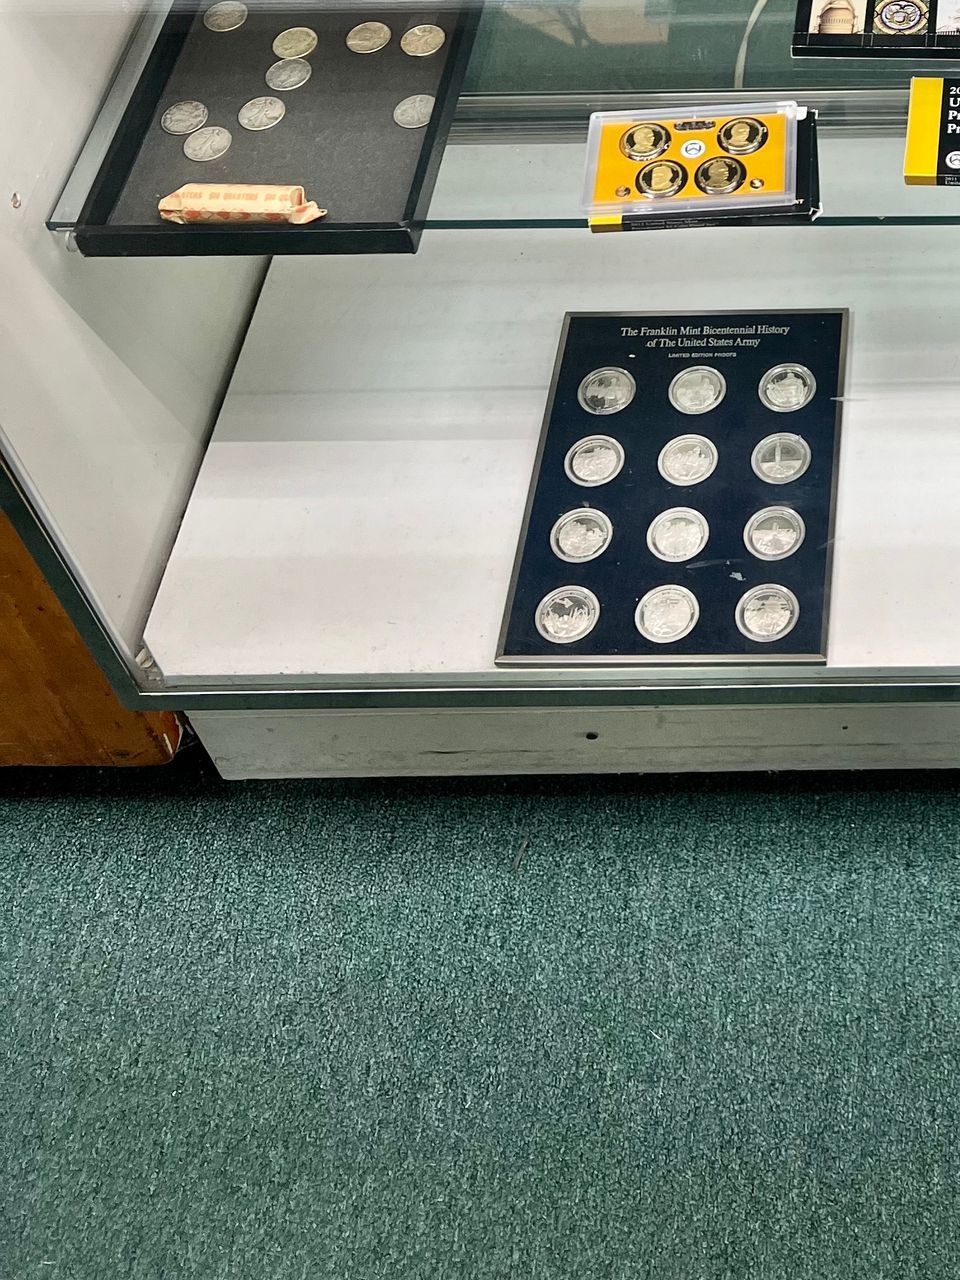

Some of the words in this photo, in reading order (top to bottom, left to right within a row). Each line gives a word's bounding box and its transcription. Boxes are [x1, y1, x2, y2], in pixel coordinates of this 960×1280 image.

[621, 327, 639, 336] The
[641, 326, 677, 336] Franklin
[680, 326, 700, 335] Mint
[702, 325, 755, 335] Bicentennial
[757, 325, 790, 337] History
[646, 339, 657, 347] of
[658, 339, 676, 347] The
[677, 337, 706, 347] United
[708, 337, 733, 346] States
[735, 337, 760, 348] Army
